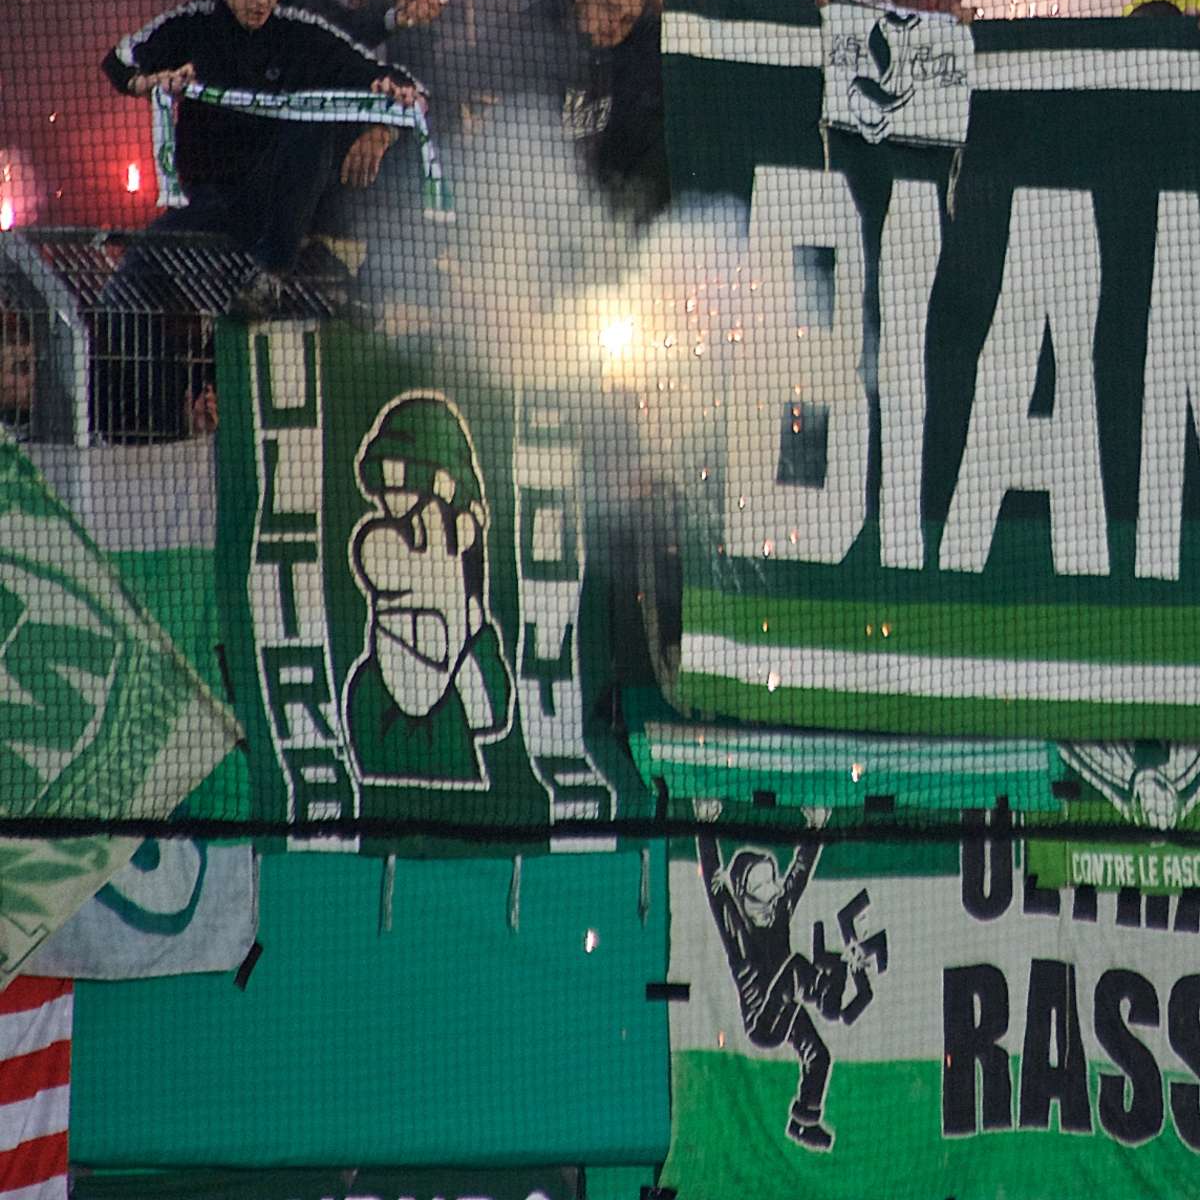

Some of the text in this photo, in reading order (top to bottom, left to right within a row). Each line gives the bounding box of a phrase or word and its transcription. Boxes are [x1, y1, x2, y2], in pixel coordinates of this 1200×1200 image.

[254, 330, 356, 822] ULTRA
[1071, 852, 1136, 887] CONTRE
[1139, 853, 1159, 887] LE
